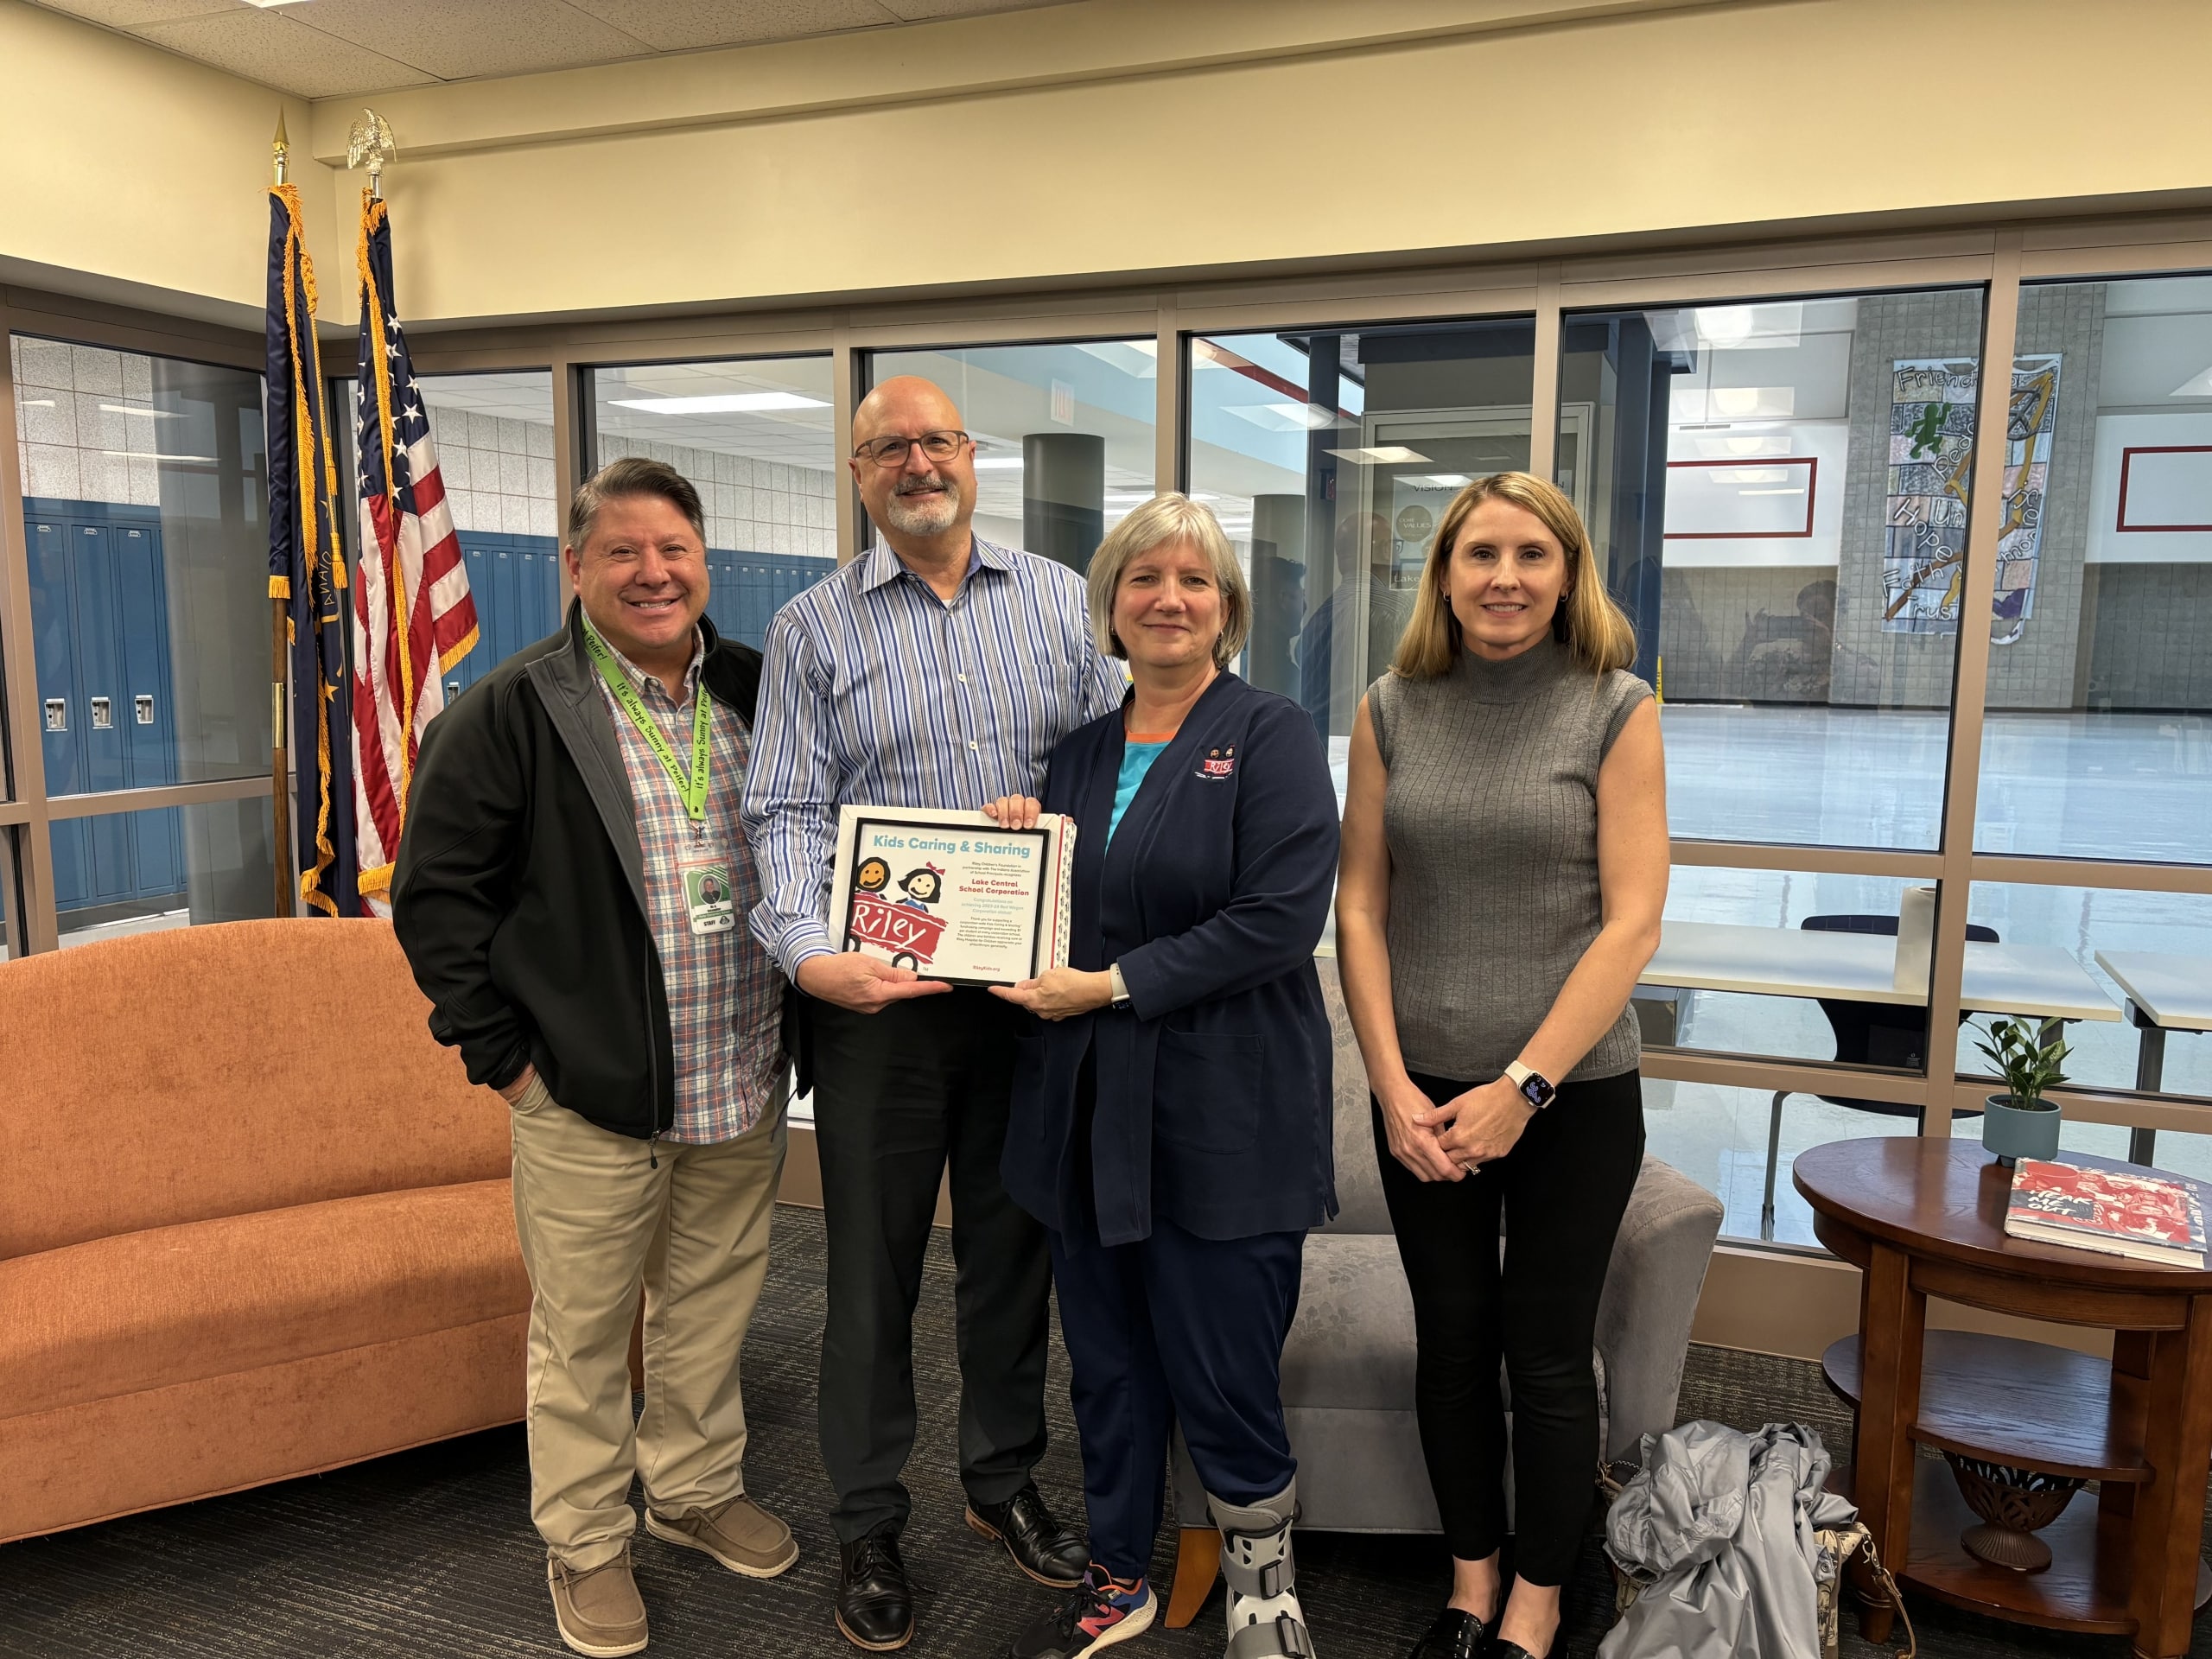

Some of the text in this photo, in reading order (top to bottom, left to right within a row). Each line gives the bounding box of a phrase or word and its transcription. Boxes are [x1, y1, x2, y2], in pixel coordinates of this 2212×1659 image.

[1894, 498, 1953, 563] Hope
[587, 635, 608, 662] Peifer!
[700, 709, 707, 719] at
[696, 721, 709, 745] Sunny
[626, 698, 646, 724] always
[645, 725, 664, 753] Sunny
[663, 754, 672, 763] at
[671, 765, 690, 792] Peifer!
[696, 748, 708, 773] always
[1210, 762, 1232, 771] Riley
[874, 835, 1030, 858] Kids Caring & Sharing
[985, 887, 1029, 896] Corporation
[852, 904, 926, 949] Riley
[2028, 1197, 2065, 1207] ME
[2028, 1203, 2077, 1215] OUT
